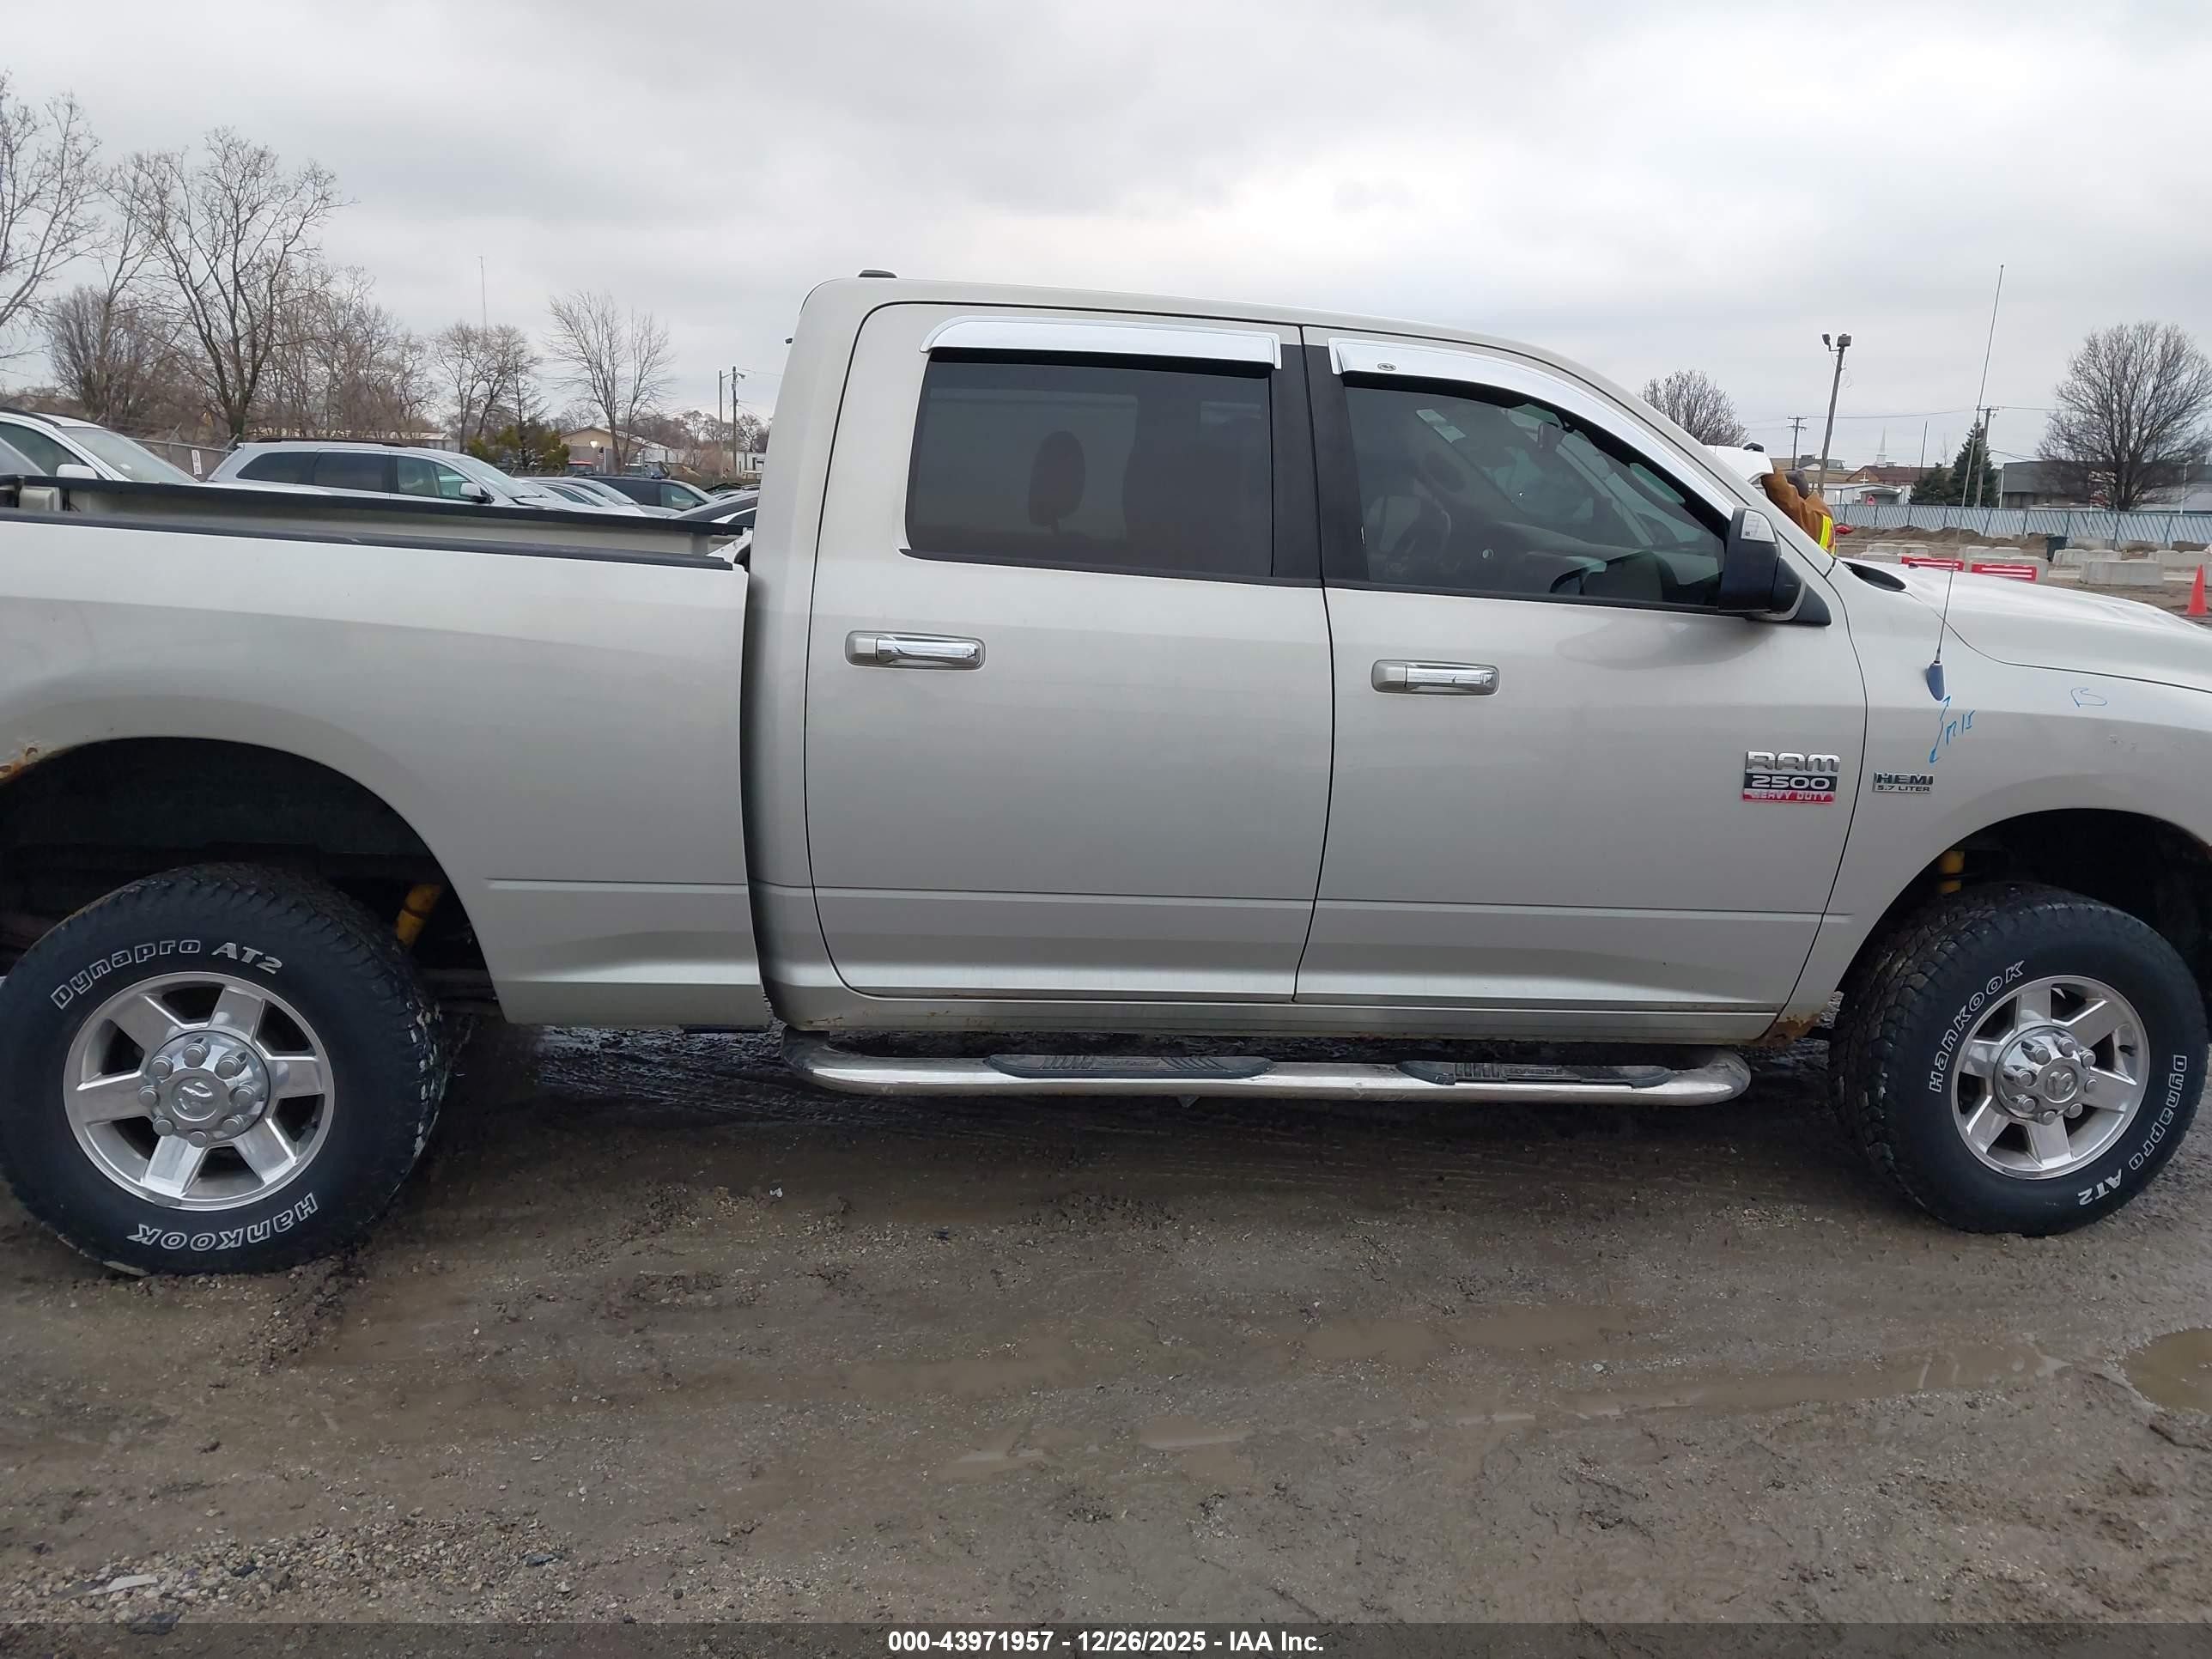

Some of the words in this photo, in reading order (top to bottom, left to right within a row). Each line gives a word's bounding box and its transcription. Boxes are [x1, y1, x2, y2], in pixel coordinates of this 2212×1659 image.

[1746, 750, 1841, 773] RAM
[1752, 775, 1830, 790] 2500
[1876, 773, 1934, 786] HEMI
[1752, 789, 1792, 799] EAVY
[1796, 792, 1826, 801] DUTY
[211, 942, 283, 975] AT2
[2077, 1168, 2123, 1206] AT2
